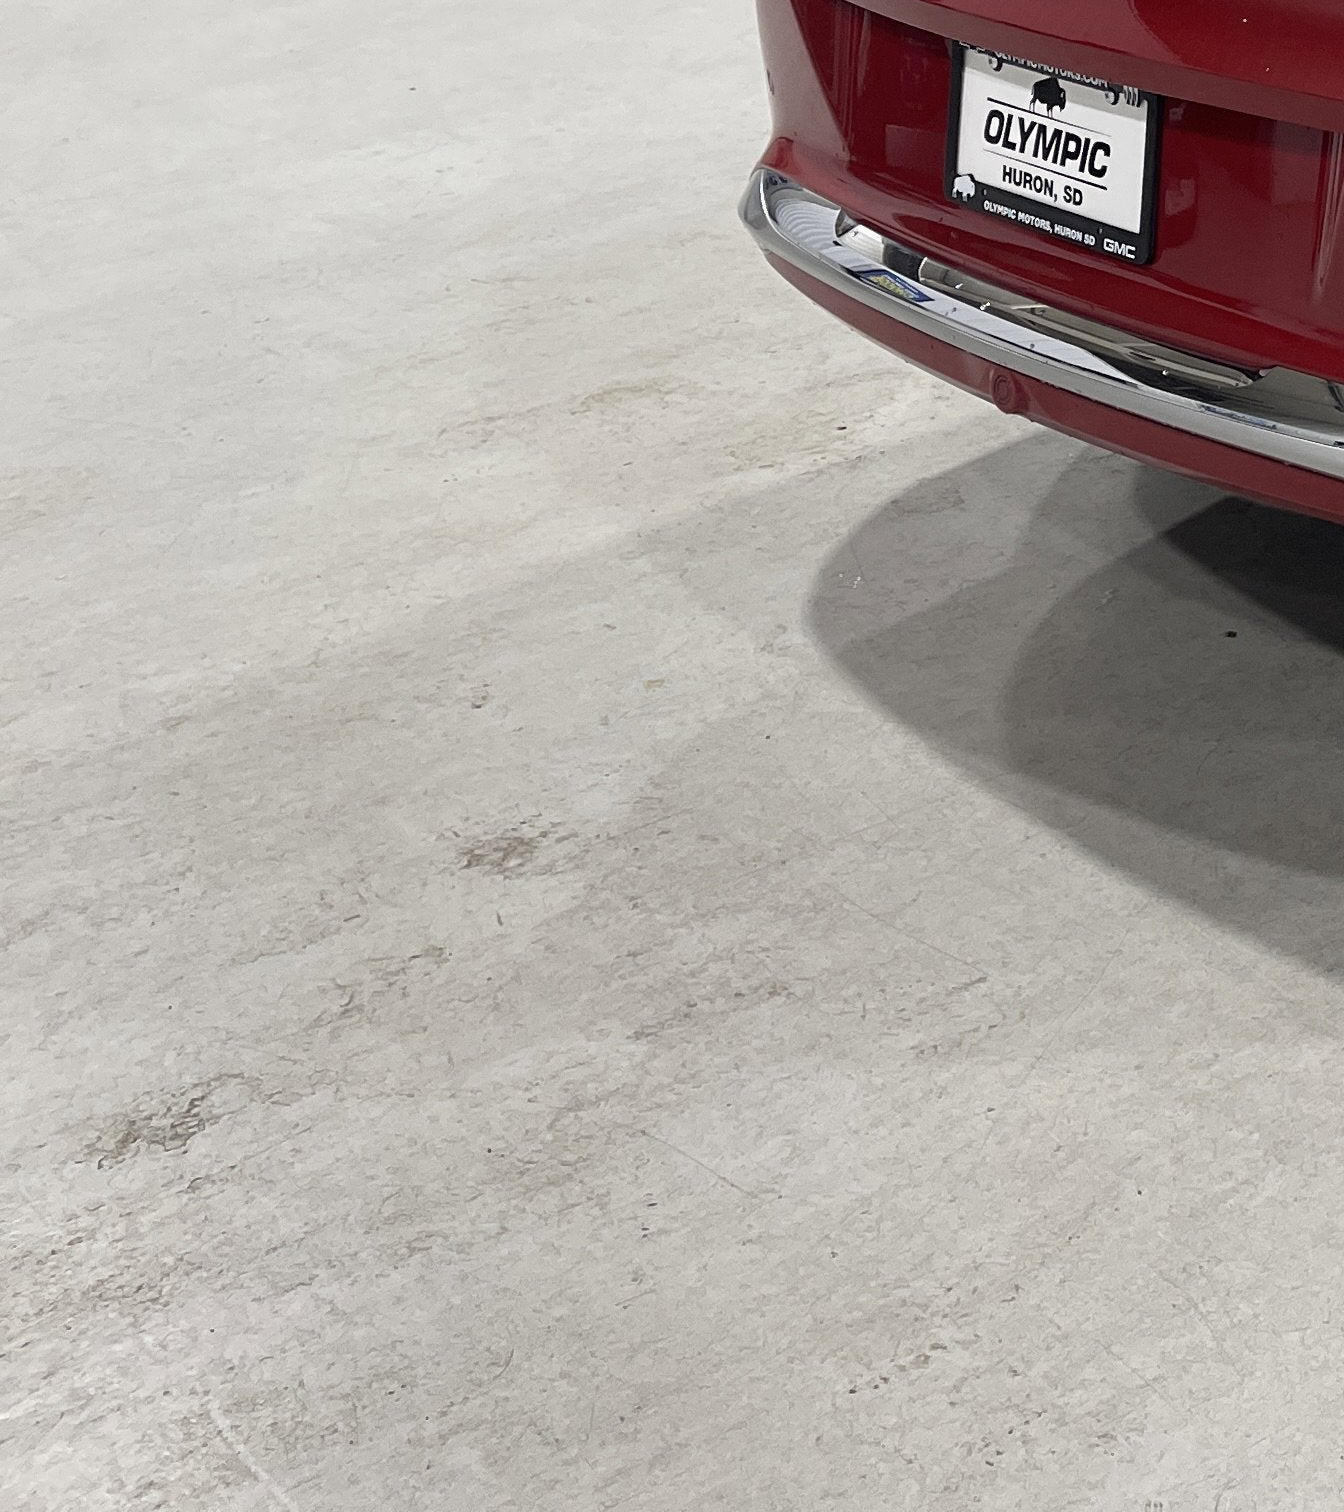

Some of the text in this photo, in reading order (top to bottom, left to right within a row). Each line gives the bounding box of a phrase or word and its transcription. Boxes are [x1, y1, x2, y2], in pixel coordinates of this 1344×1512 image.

[983, 109, 1111, 178] OLYMPIC
[1002, 165, 1083, 206] HURON, SD
[983, 200, 1096, 246] OLYMPIC MOTORS, HURON SD
[1103, 238, 1136, 259] GMC
